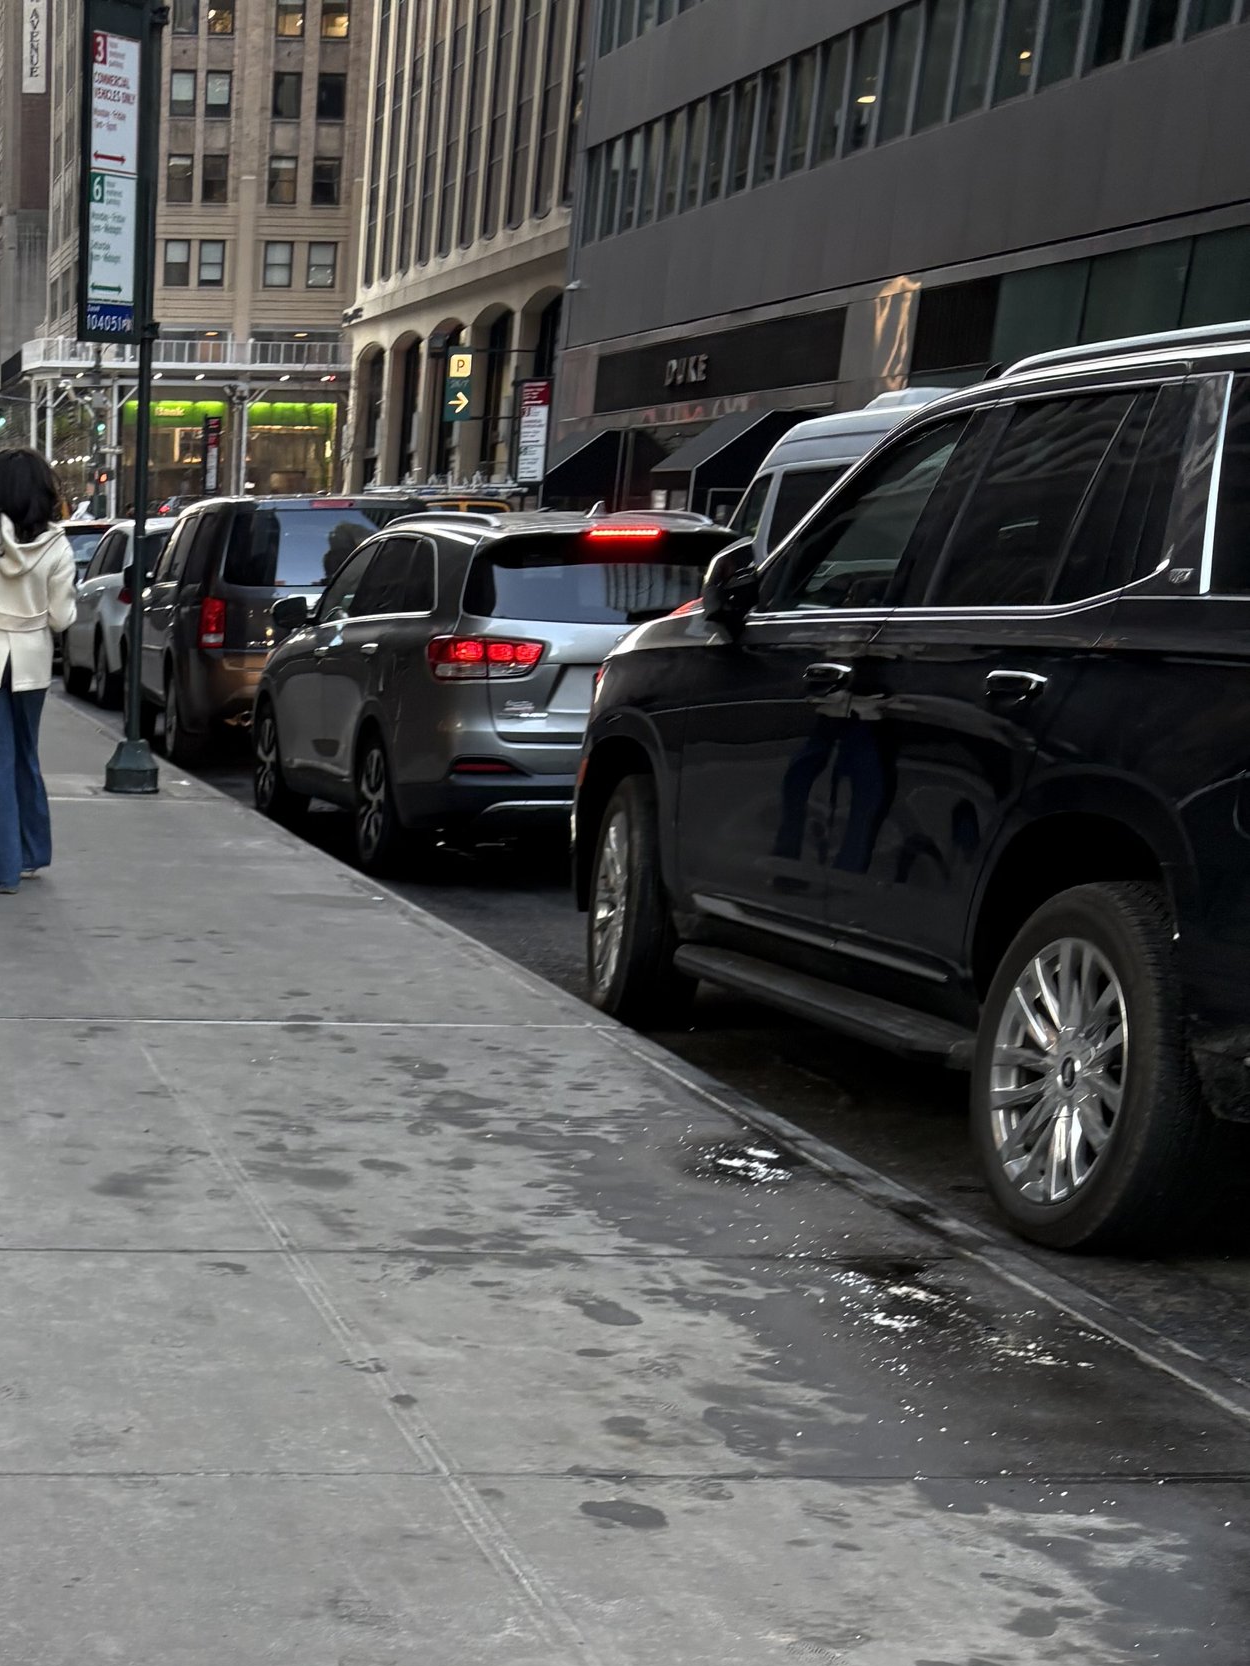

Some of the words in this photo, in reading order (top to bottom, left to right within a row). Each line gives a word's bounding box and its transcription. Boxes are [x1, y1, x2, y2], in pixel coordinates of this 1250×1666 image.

[29, 8, 40, 78] AVENUE
[95, 35, 104, 62] 3
[93, 175, 102, 201] 6
